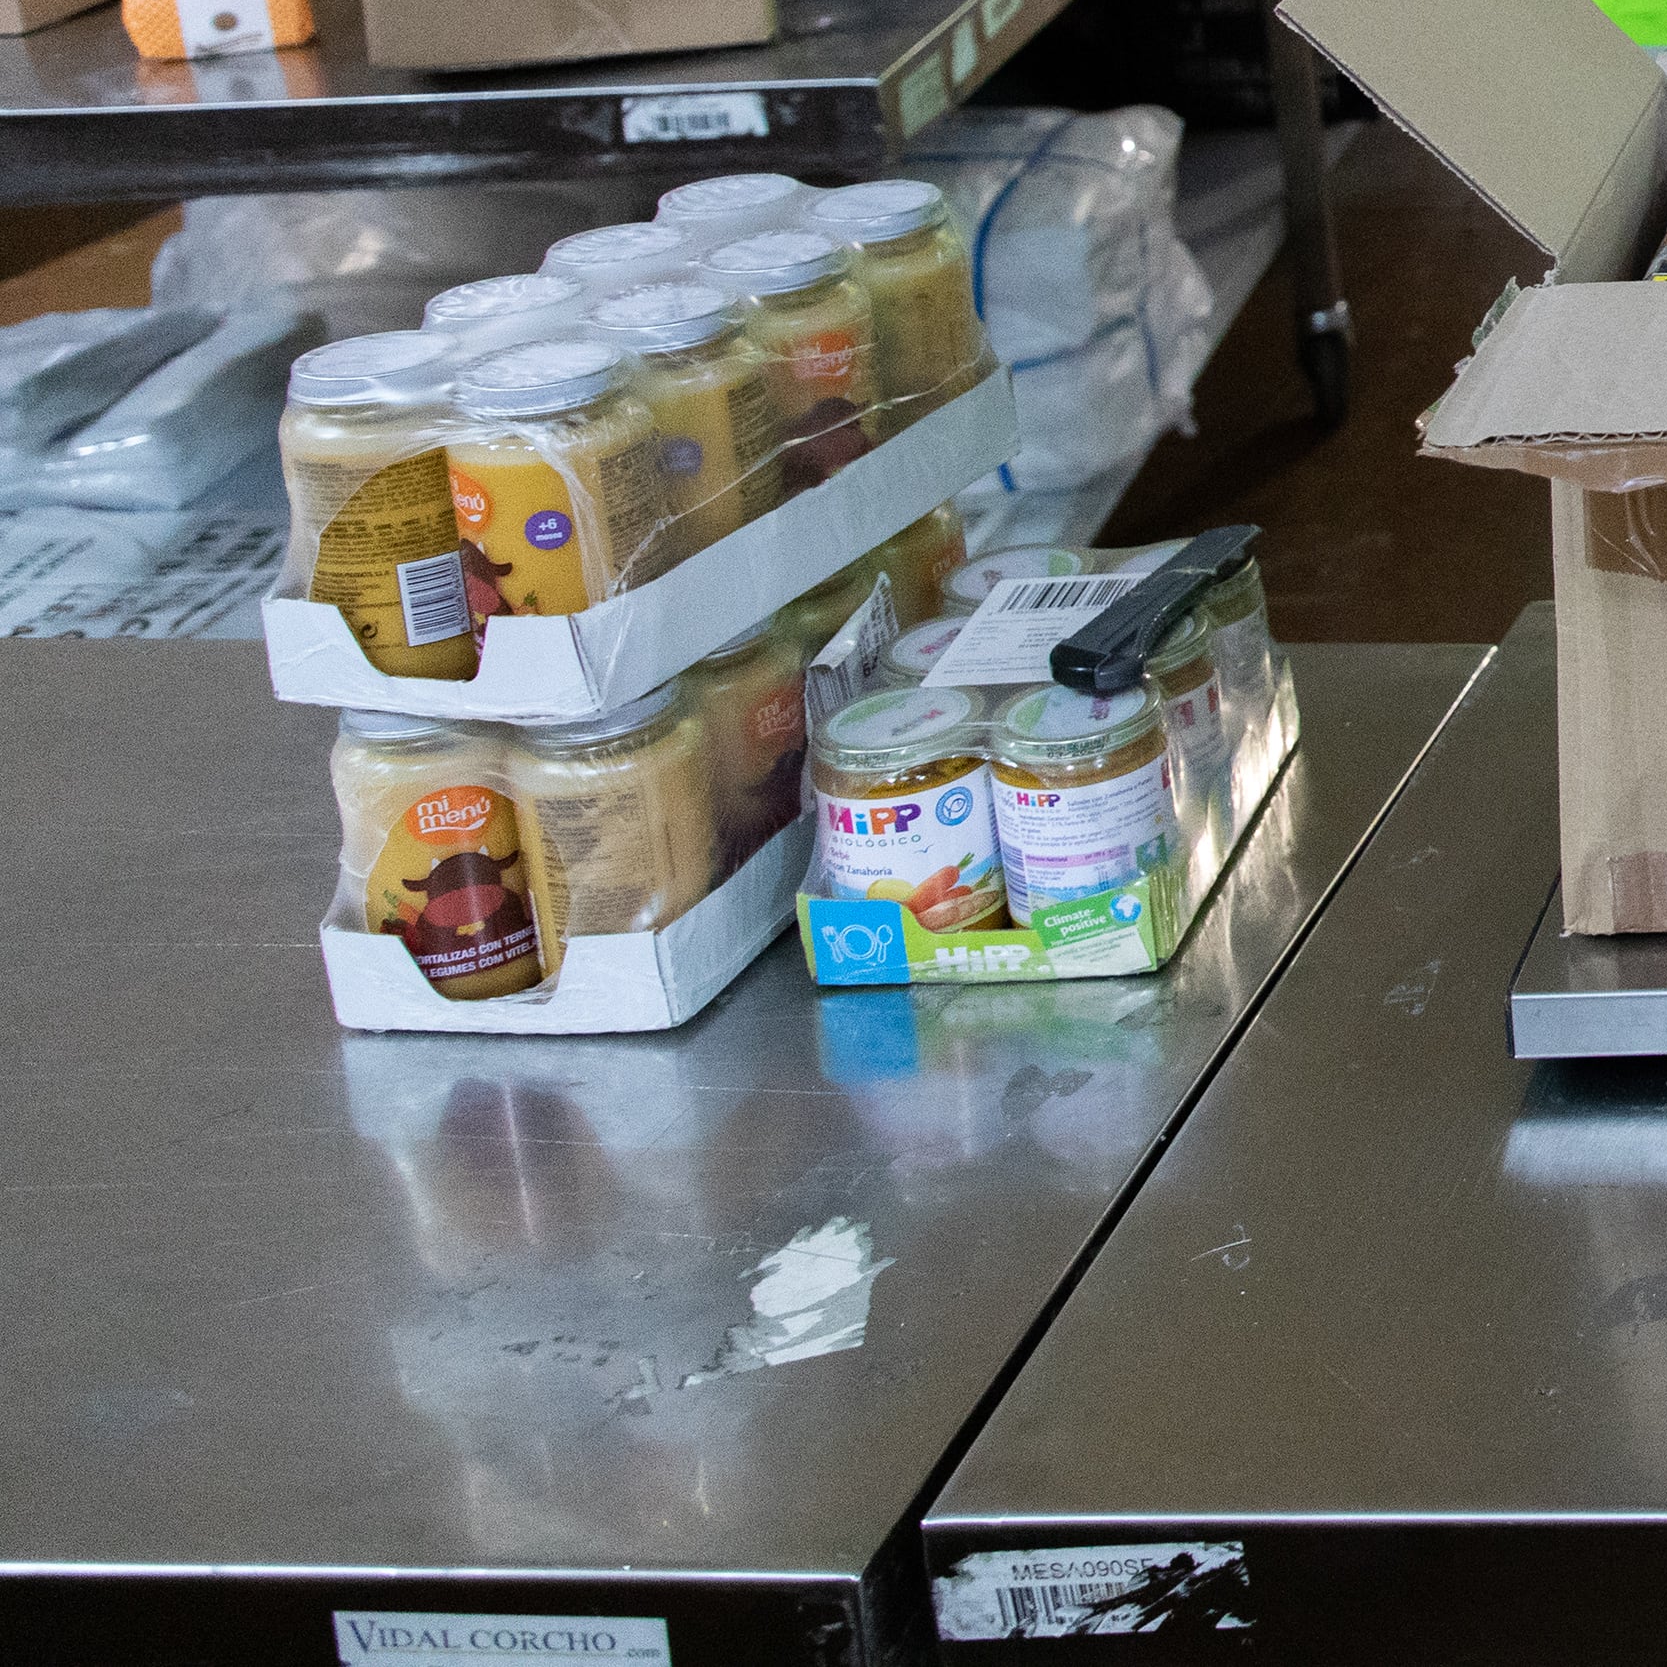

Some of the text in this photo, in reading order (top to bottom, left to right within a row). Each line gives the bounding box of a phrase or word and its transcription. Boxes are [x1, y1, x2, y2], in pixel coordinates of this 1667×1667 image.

[539, 517, 558, 532] +6
[416, 794, 450, 817] mi
[1016, 791, 1062, 808] HiPP
[417, 795, 492, 831] menú
[827, 802, 922, 835] HiPP
[831, 834, 923, 848] BIOLÓGICO
[847, 864, 894, 877] Zanahoria
[1044, 906, 1096, 929] Climate-
[1060, 914, 1107, 938] positive
[478, 936, 502, 955] CON
[501, 925, 536, 946] TERNE
[478, 953, 505, 970] COM
[934, 943, 1032, 974] HiPP
[346, 1619, 453, 1654] VIDAL
[469, 1629, 618, 1653] CORCHO
